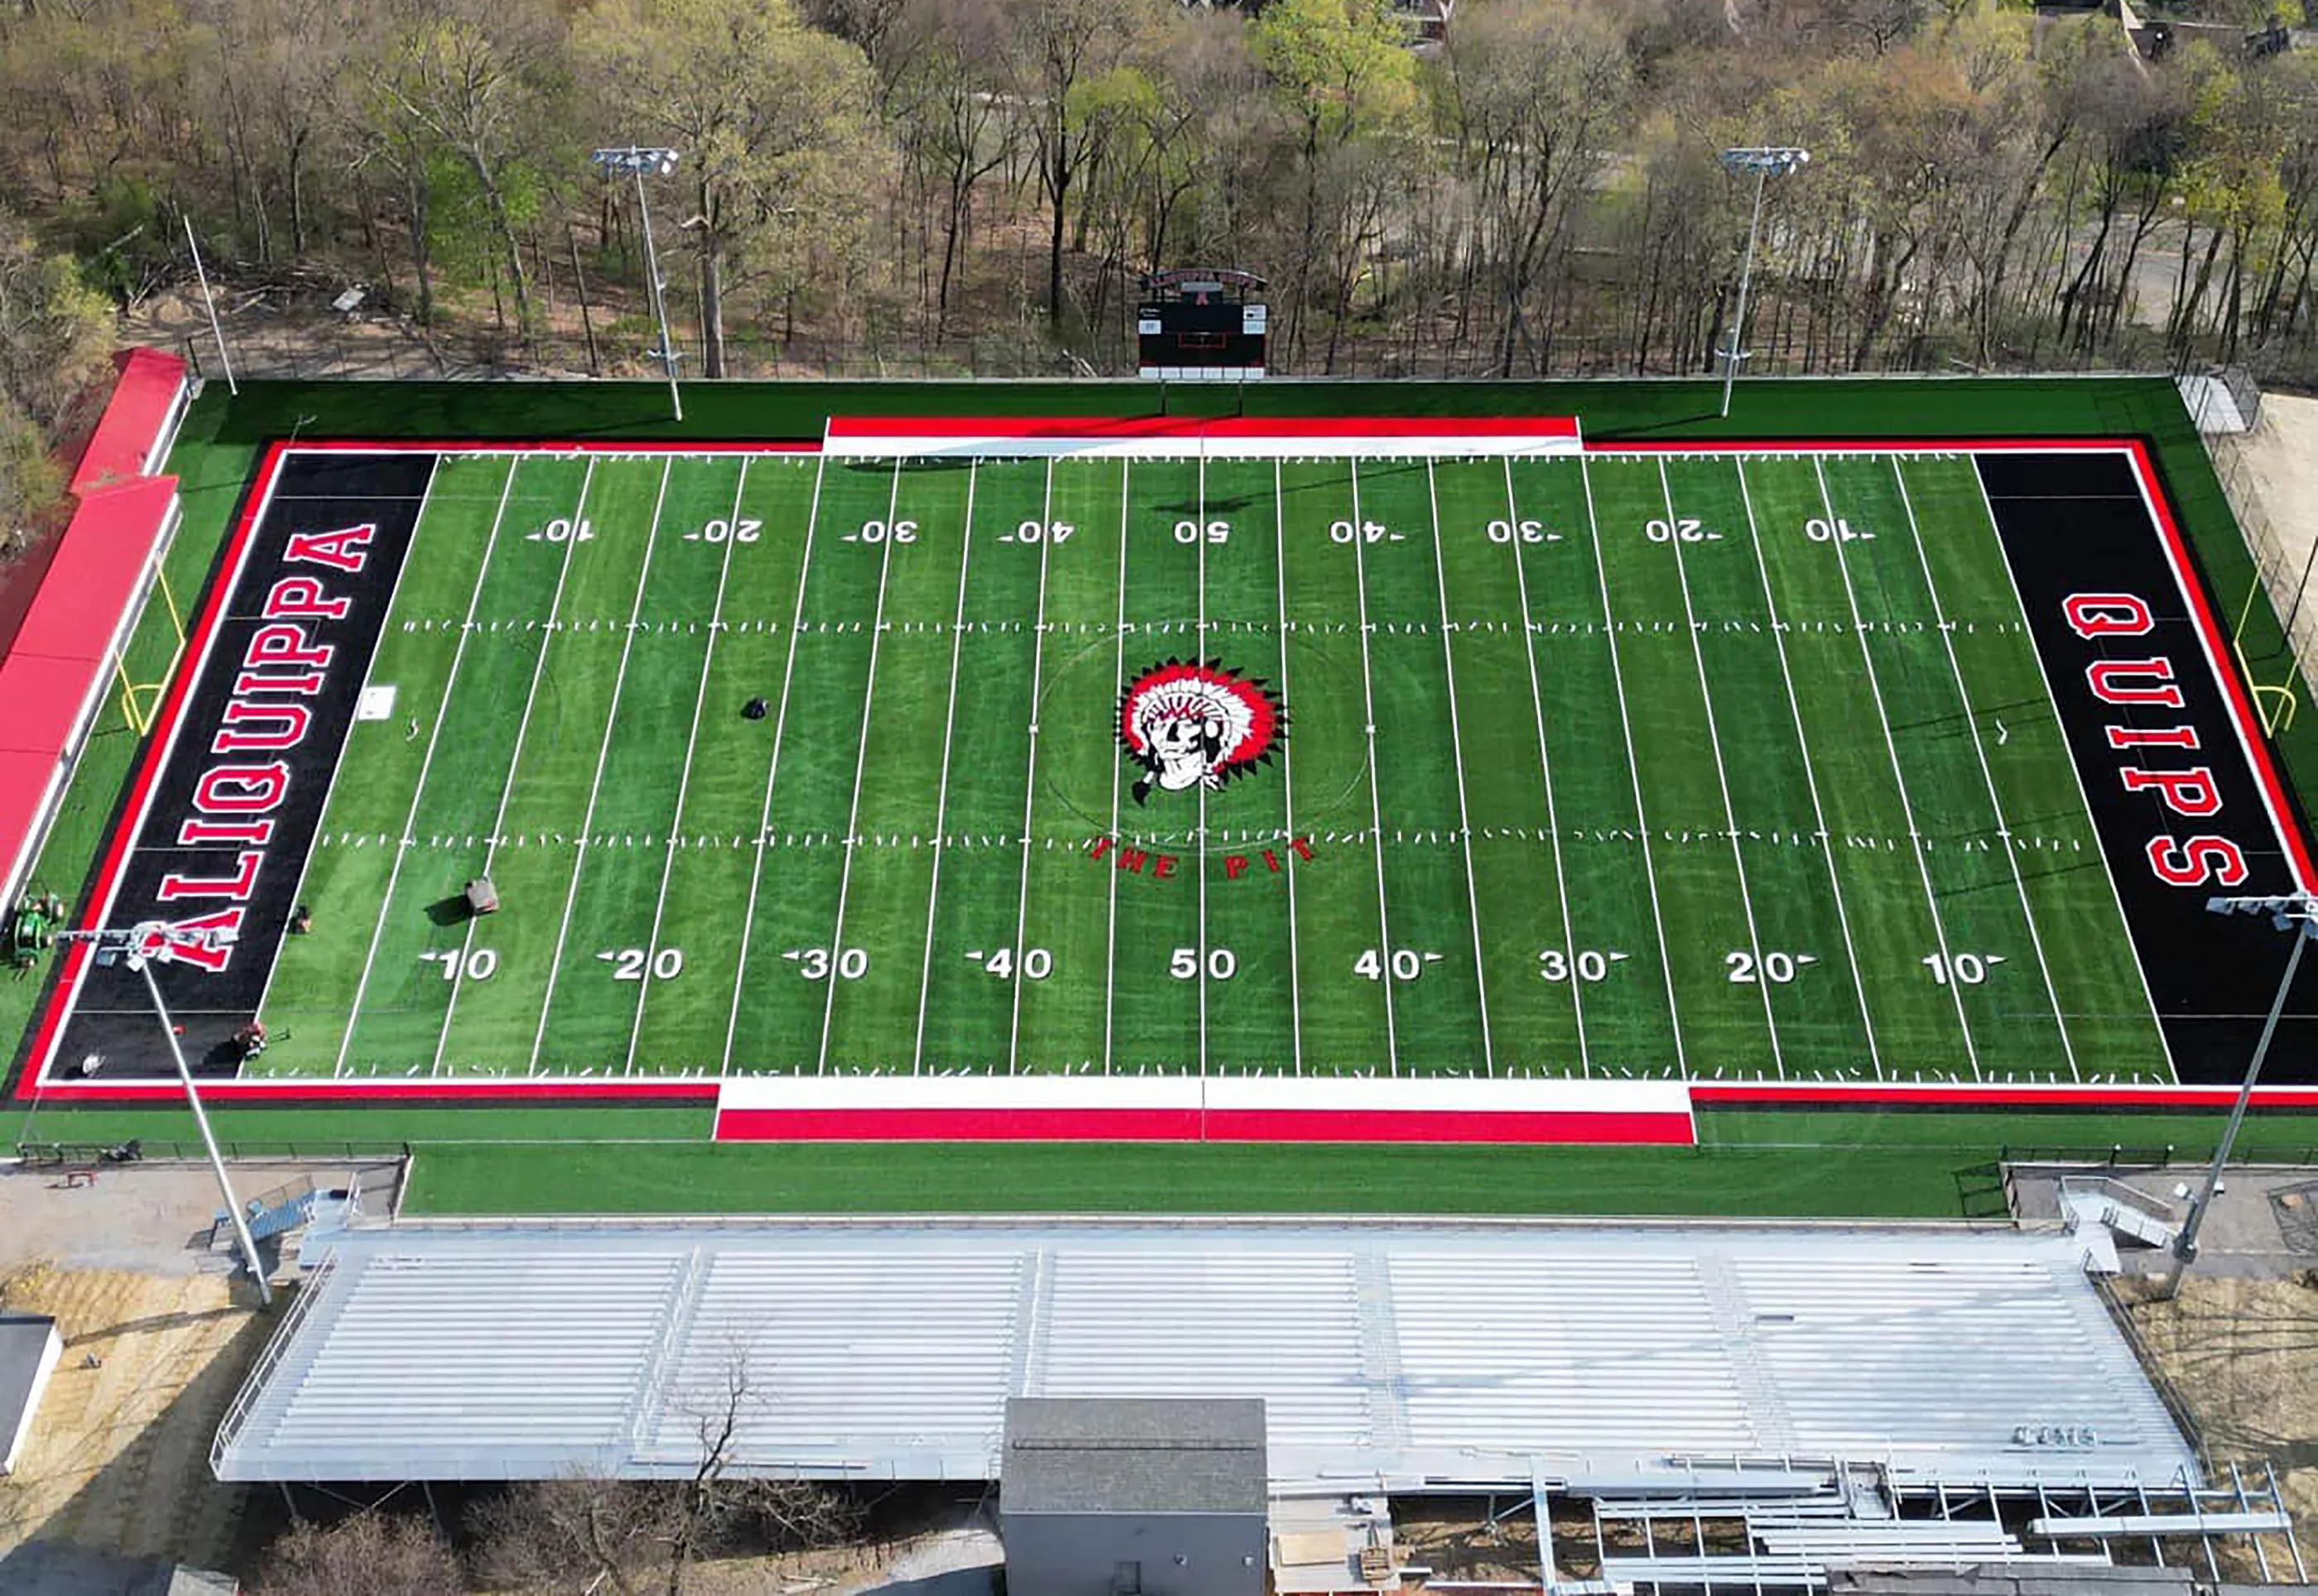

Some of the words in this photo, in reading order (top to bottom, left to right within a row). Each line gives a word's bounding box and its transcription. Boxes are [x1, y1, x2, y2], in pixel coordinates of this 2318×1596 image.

[546, 517, 594, 542] 10
[705, 519, 762, 543] 20
[862, 521, 919, 543] 30
[1018, 521, 1075, 543] 40
[1174, 521, 1230, 544] 50
[1330, 521, 1387, 544] 40
[1487, 520, 1544, 543] 30
[1646, 519, 1704, 542] 20
[1805, 519, 1858, 542] 10
[138, 523, 377, 972] ALIQUIPPA
[2062, 594, 2248, 886] QUIPS
[1090, 836, 1178, 879] THE
[1224, 836, 1315, 880] PIT
[438, 948, 503, 980] 10
[613, 948, 686, 980] 20
[800, 948, 868, 979] 30
[985, 948, 1051, 979] 40
[1170, 948, 1235, 979] 50
[1354, 949, 1420, 980] 40
[1539, 950, 1606, 981] 30
[1725, 952, 1794, 983] 20
[1921, 953, 1984, 984] 10
